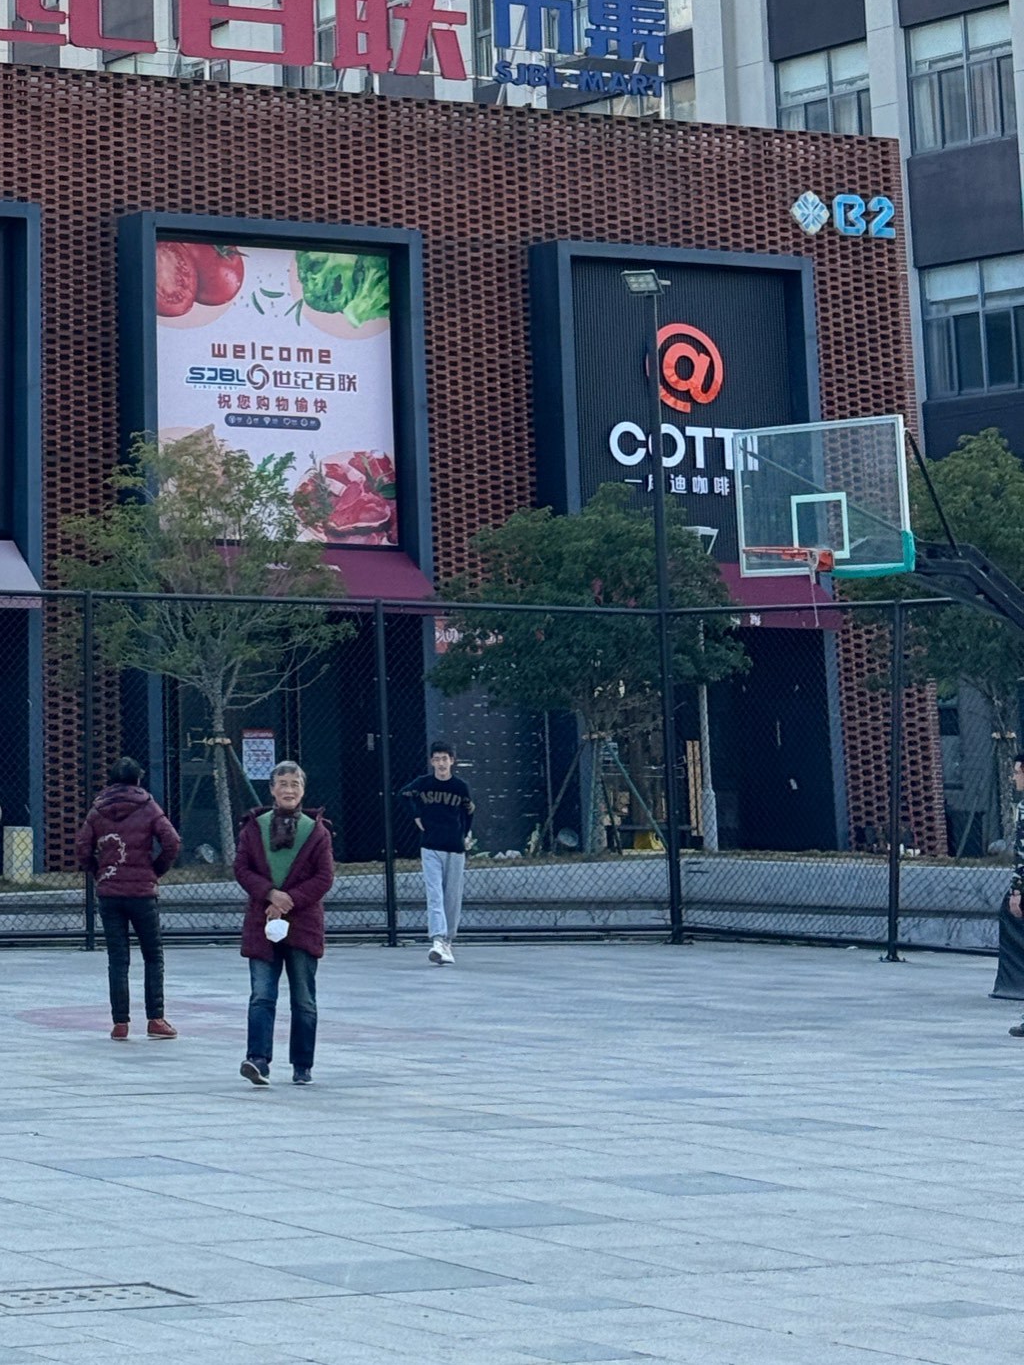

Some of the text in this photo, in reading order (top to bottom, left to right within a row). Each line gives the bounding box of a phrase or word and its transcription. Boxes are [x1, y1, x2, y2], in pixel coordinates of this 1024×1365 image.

[832, 194, 896, 239] B2
[211, 342, 331, 364] welcome
[189, 366, 358, 393] SJBL 世纪百联
[217, 392, 328, 414] 祝您购物愉快
[647, 473, 730, 496] 迪咖啡
